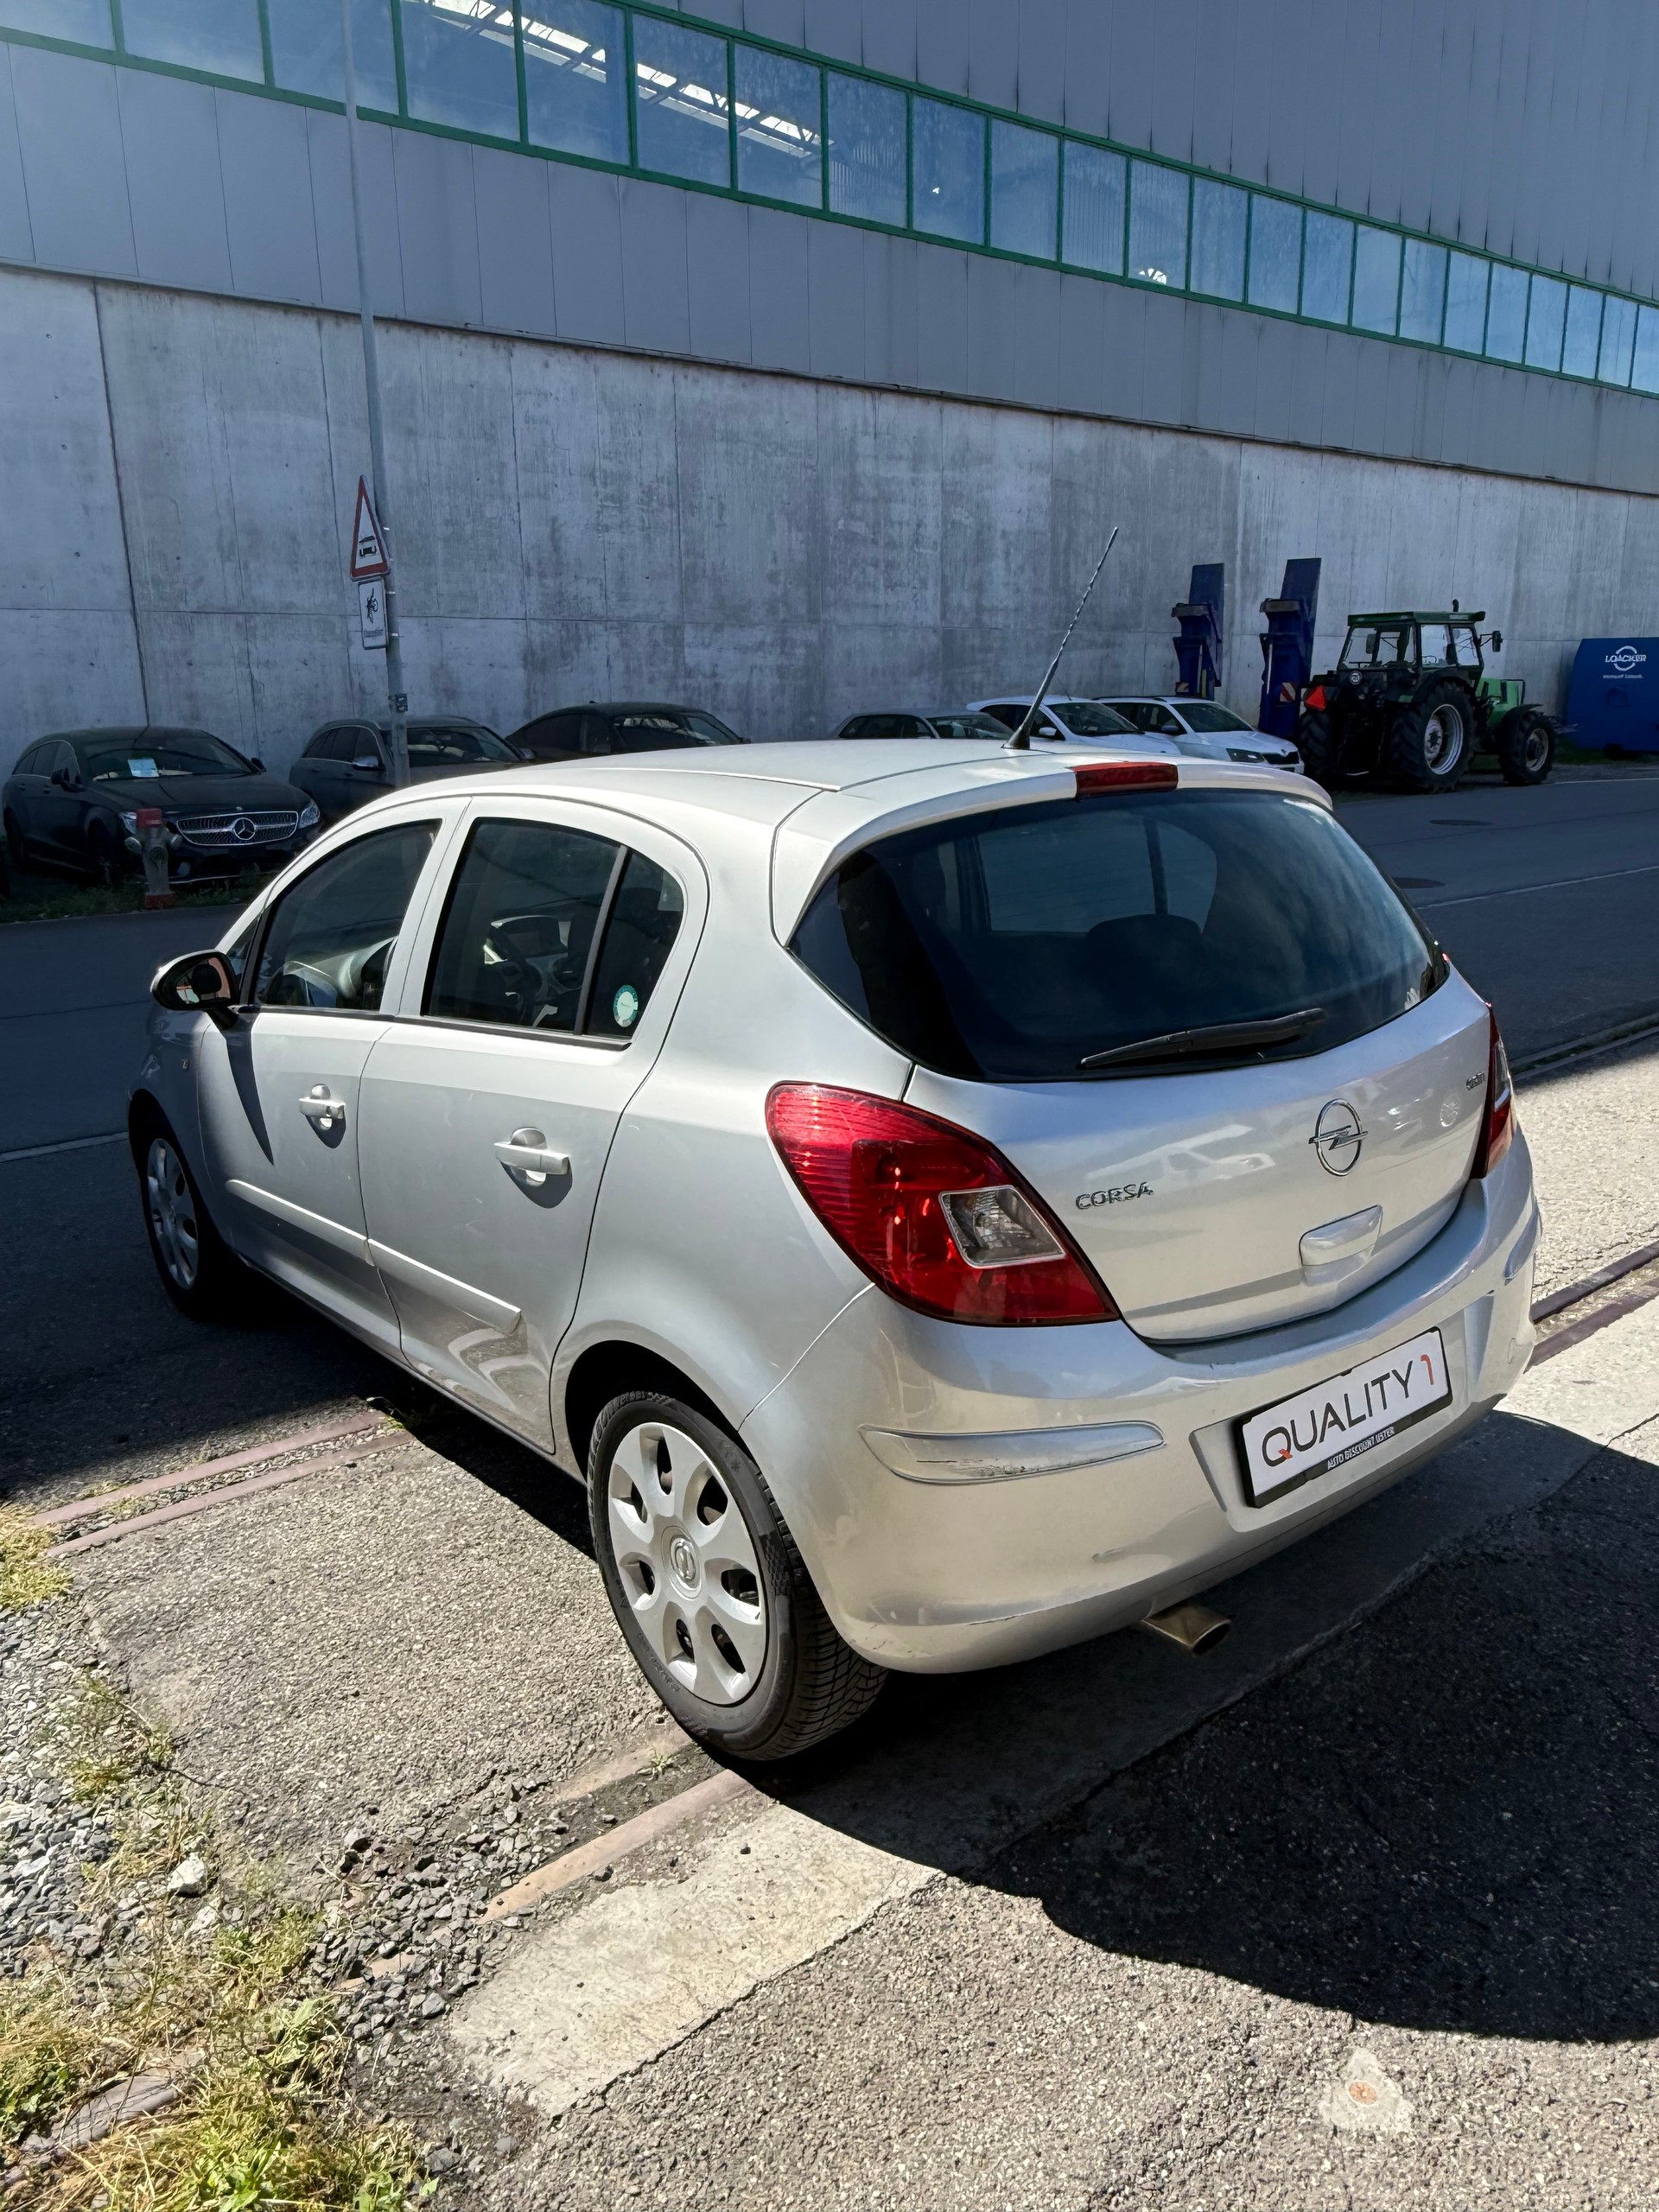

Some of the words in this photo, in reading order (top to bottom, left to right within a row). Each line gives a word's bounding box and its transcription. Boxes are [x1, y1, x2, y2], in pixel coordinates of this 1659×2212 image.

[1076, 1181, 1154, 1210] CORSA
[1262, 1360, 1413, 1467] QUALITY
[1327, 1453, 1344, 1470] AUTO
[1344, 1436, 1375, 1460] DISCOUNT
